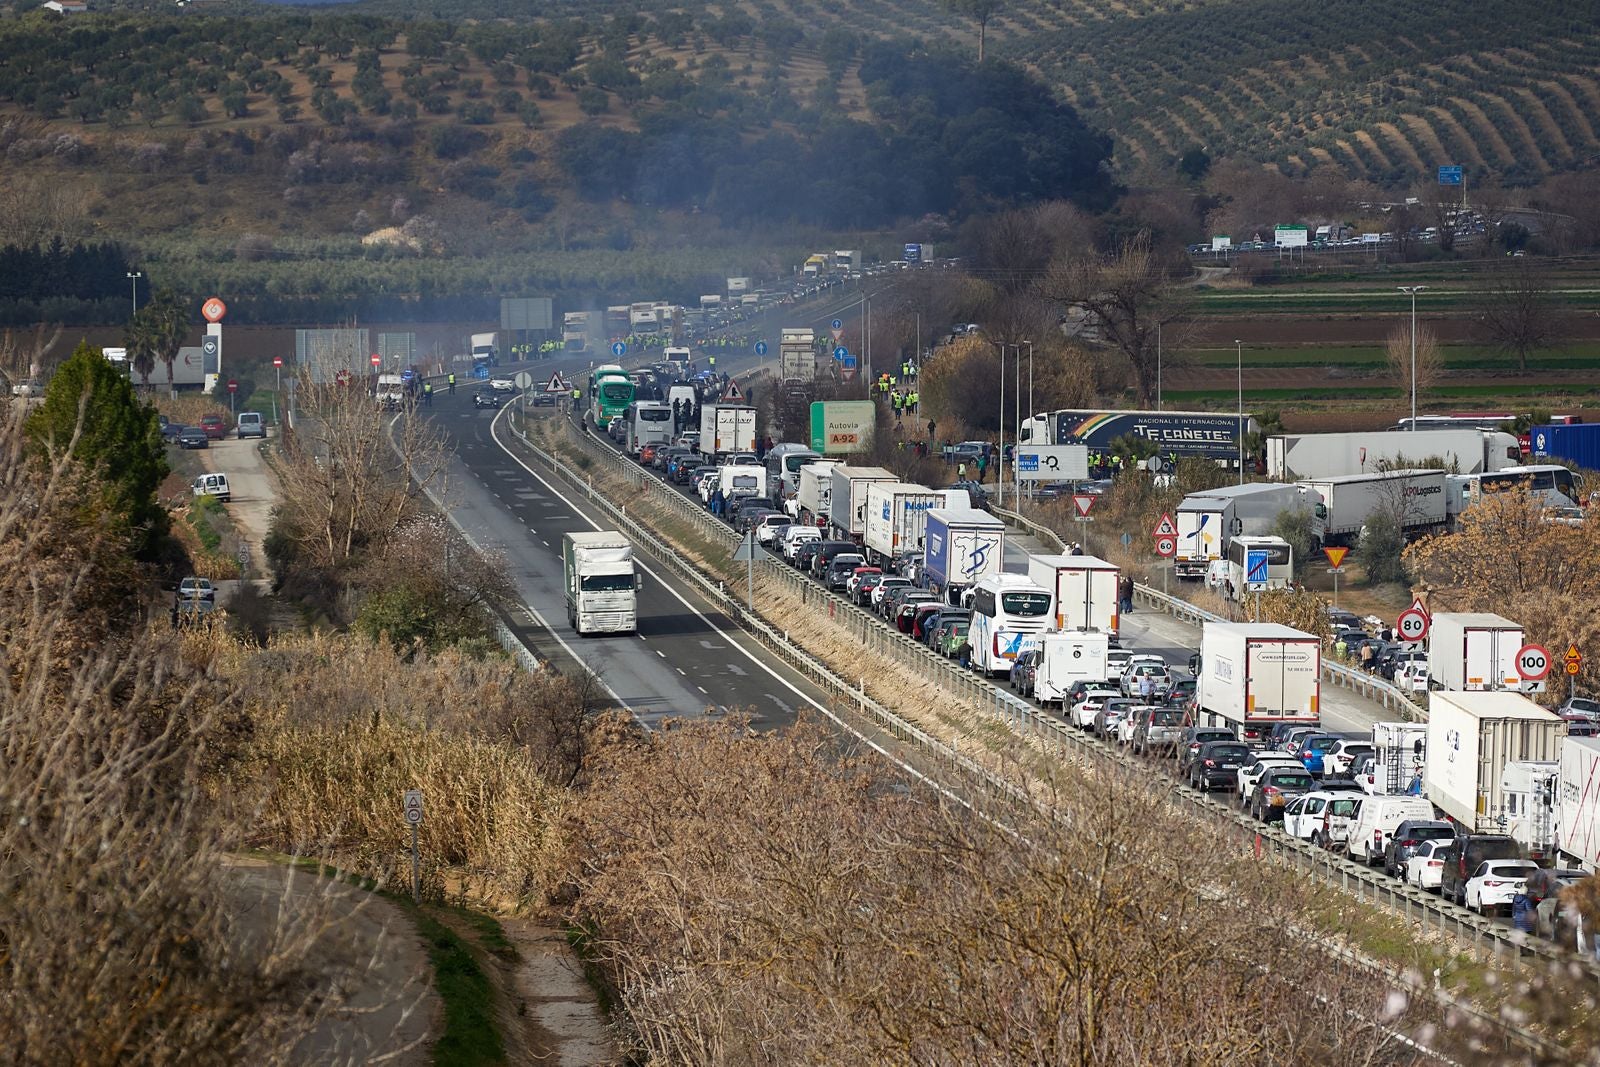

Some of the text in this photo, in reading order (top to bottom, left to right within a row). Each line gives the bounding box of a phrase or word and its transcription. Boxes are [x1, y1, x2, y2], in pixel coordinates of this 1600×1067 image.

[833, 434, 854, 443] A-92
[1403, 620, 1422, 631] 80
[1521, 656, 1545, 668] 100
